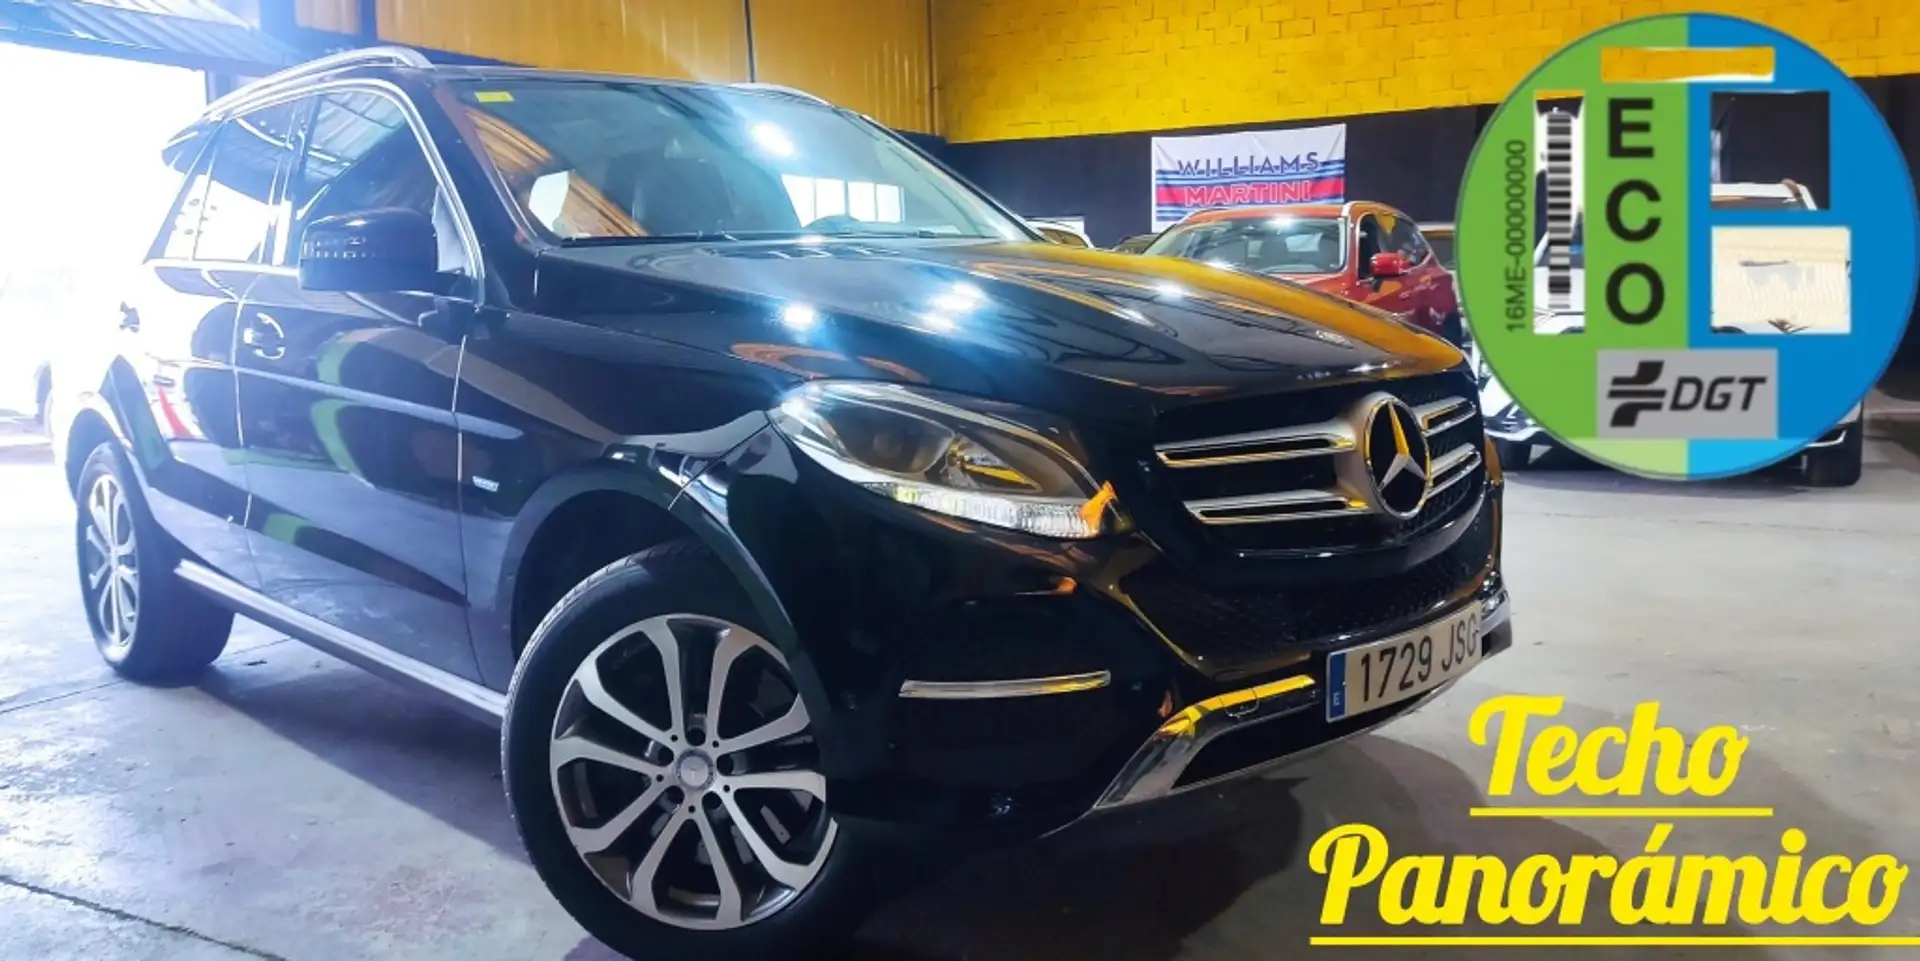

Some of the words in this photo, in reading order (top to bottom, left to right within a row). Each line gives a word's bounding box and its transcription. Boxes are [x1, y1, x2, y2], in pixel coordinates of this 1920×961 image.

[1178, 152, 1319, 178] WILLIAMS
[1183, 180, 1313, 207] MARTINI
[1332, 692, 1341, 706] E
[1360, 635, 1433, 702] 1729
[1441, 612, 1480, 672] JSG
